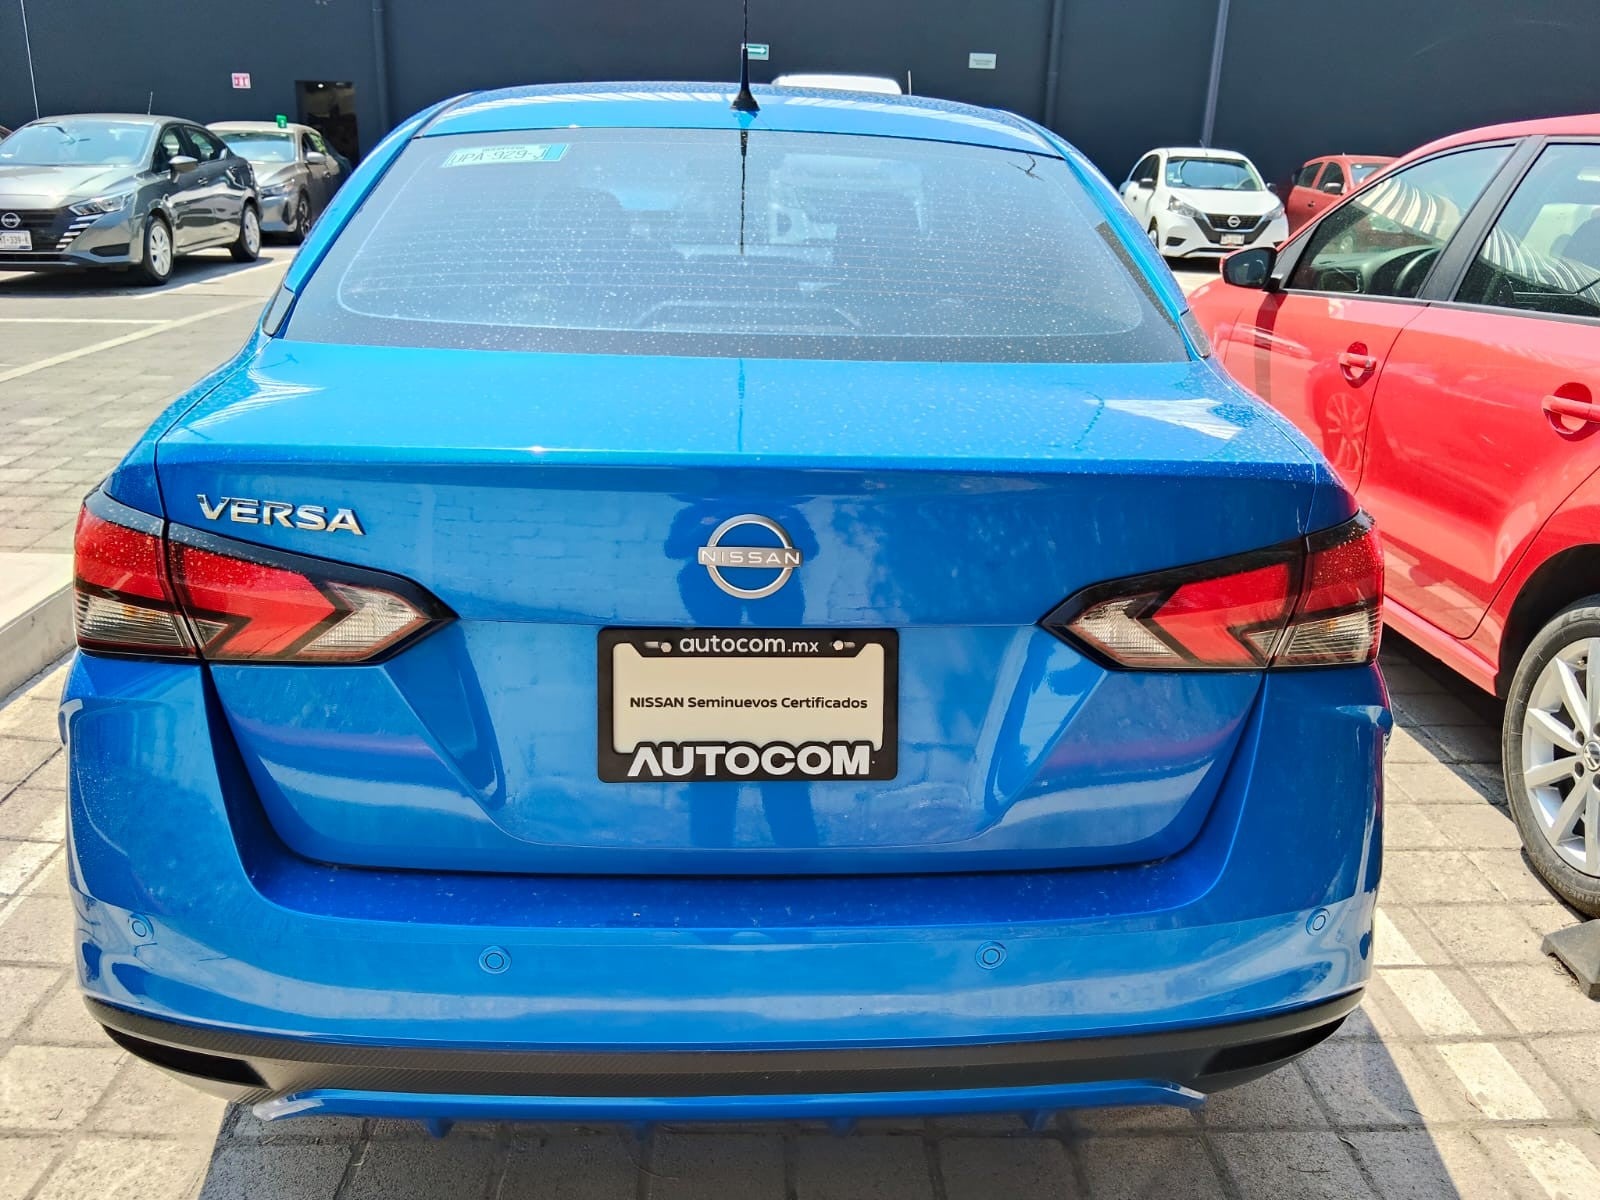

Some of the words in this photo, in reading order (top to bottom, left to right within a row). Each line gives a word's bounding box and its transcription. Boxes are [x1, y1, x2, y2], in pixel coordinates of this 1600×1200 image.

[196, 494, 367, 536] VERSA
[700, 550, 800, 565] NISSAN
[679, 635, 819, 653] autocom.mx
[629, 696, 684, 708] NISSAN
[687, 696, 778, 709] Seminuevos
[781, 695, 868, 710] Certificados
[627, 745, 870, 776] AUTOCOM
